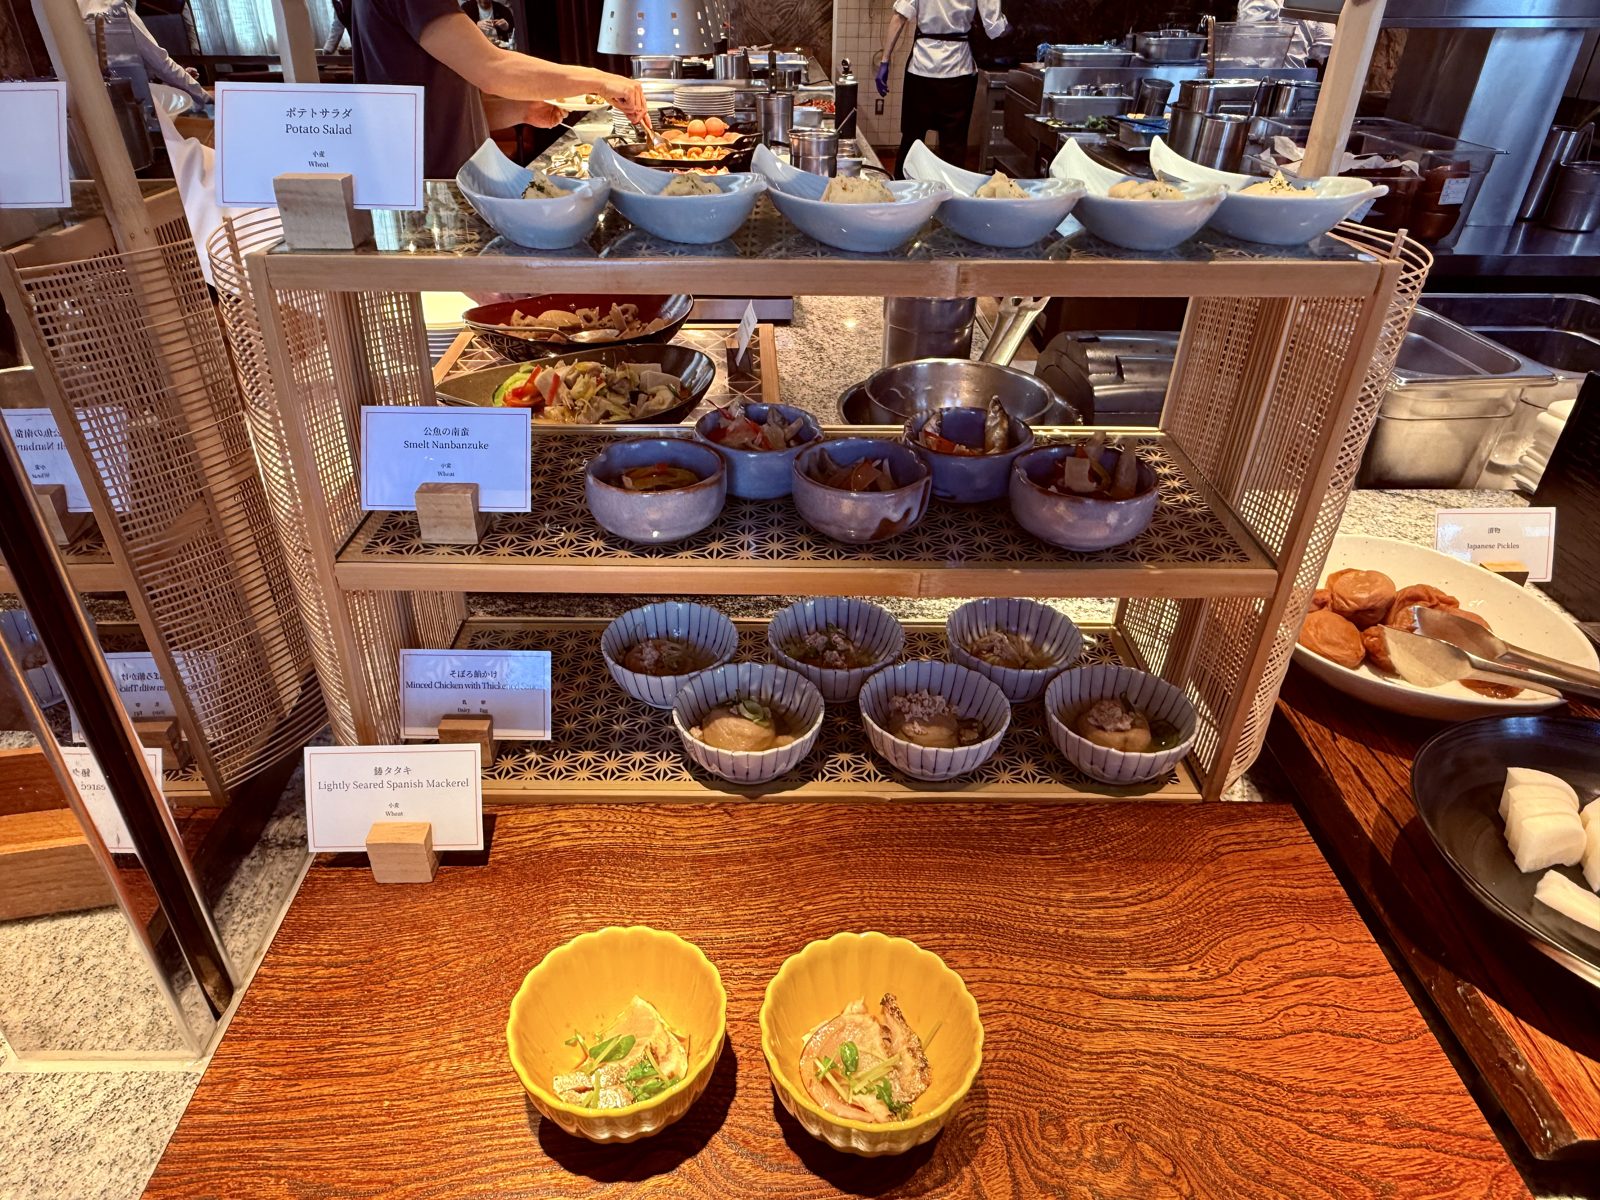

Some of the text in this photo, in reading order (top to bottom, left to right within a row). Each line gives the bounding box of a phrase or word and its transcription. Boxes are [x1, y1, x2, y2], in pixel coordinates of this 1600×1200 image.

[286, 108, 353, 119] ポテトサラダ
[285, 124, 352, 135] Potato Salad
[423, 426, 470, 437] 公魚の南蛮
[403, 440, 489, 450] Smelt Nanbanzuke
[1466, 542, 1495, 550] Japanese
[405, 681, 433, 689] Minced
[434, 681, 464, 690] Chicken
[464, 681, 481, 690] with
[318, 778, 470, 792] Lightly Seared Spanish Mackerel
